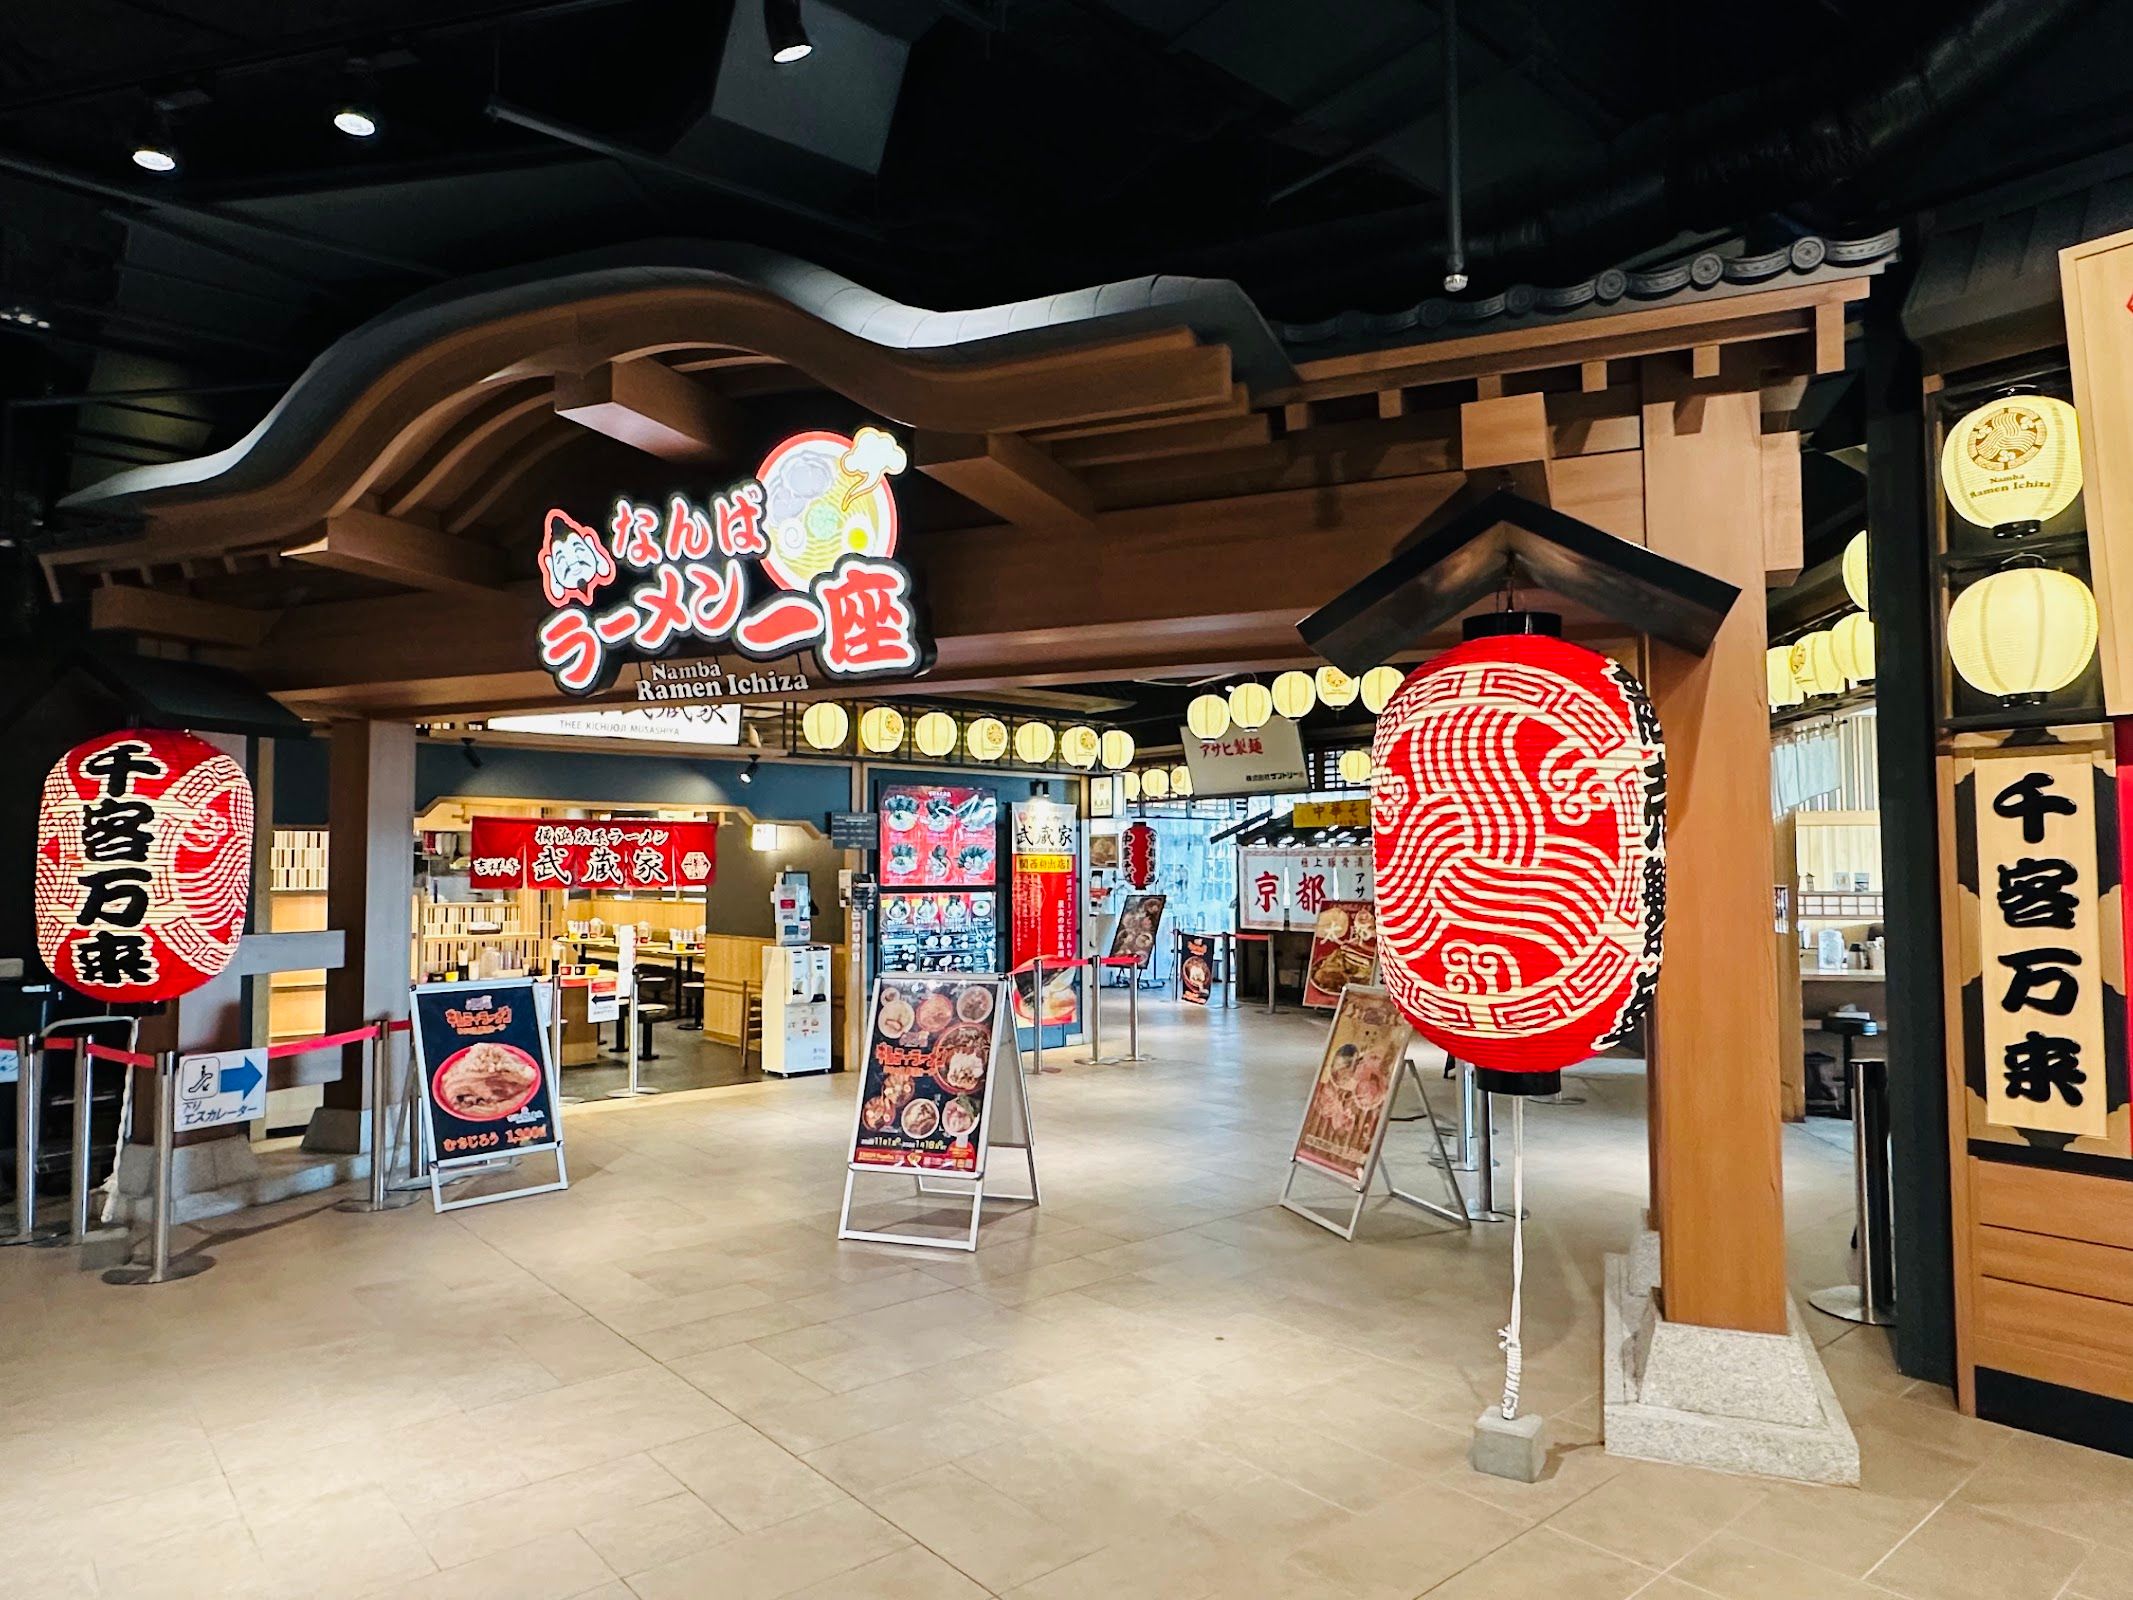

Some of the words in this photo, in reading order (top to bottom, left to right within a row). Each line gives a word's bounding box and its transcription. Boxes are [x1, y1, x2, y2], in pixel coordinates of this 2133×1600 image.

[1969, 485, 2009, 499] Ramen
[611, 483, 769, 568] なんば
[540, 560, 919, 690] ラーメン一座
[650, 661, 722, 681] Namba
[635, 679, 723, 701] Ramen
[726, 670, 809, 696] Ichiza
[1200, 737, 1263, 758] アサヒ製麺
[534, 825, 669, 846] 横浜家系ラーメン
[1016, 823, 1073, 848] 武蔵家
[76, 742, 164, 984] 千客万来
[532, 845, 669, 885] 武蔵家
[1254, 870, 1327, 915] 京都
[1992, 772, 2087, 1107] 千客万来
[183, 1100, 202, 1113] 下り
[184, 1104, 258, 1125] エスカレーター
